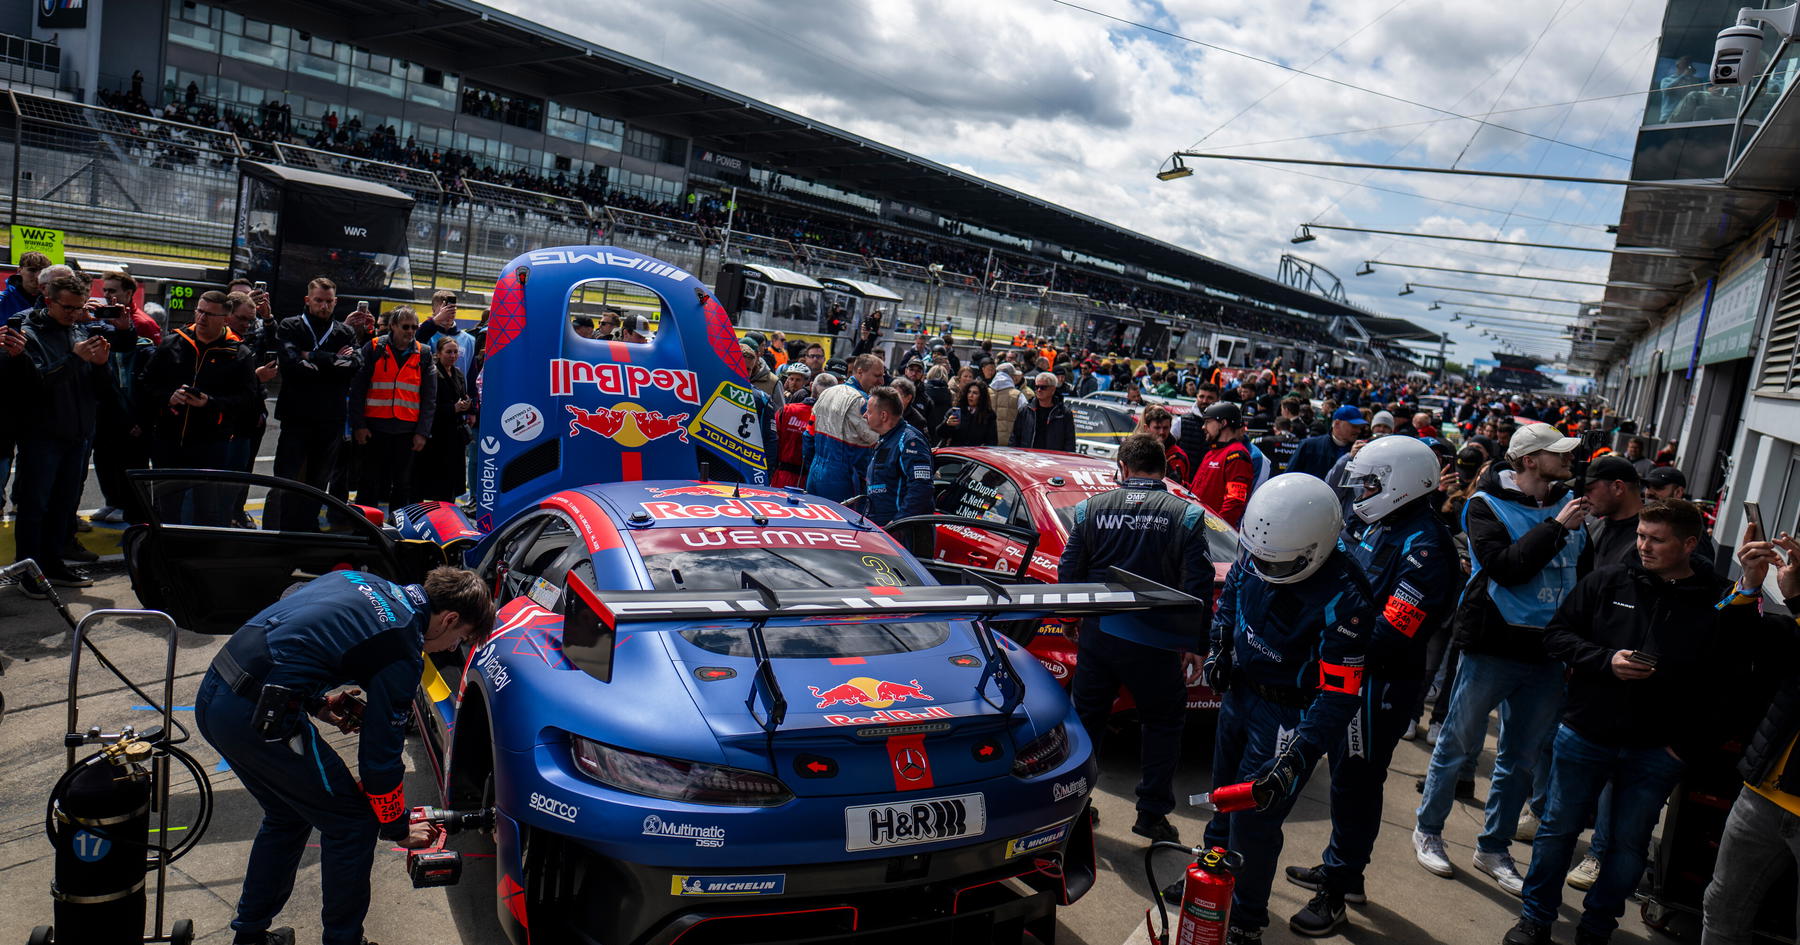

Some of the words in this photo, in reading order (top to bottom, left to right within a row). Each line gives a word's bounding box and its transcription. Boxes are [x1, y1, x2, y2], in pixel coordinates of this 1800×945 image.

[715, 156, 742, 170] POWER
[737, 413, 756, 439] 3
[703, 428, 762, 461] RAVENOL
[480, 458, 495, 512] viaplay
[752, 468, 766, 486] ay
[1067, 470, 1119, 487] NE
[680, 529, 862, 549] WEMPE
[961, 527, 986, 542] Sport
[861, 555, 903, 588] 3
[1251, 639, 1282, 663] RACING
[486, 654, 511, 692] viaplay
[1351, 714, 1361, 752] RAVE
[1060, 777, 1087, 796] Multimatic
[530, 792, 578, 820] sparco
[661, 823, 726, 838] Multimatic
[869, 802, 933, 846] H&R
[75, 831, 108, 859] 17
[1027, 829, 1065, 849] MICHELIN
[706, 880, 776, 892] MICHELIN
